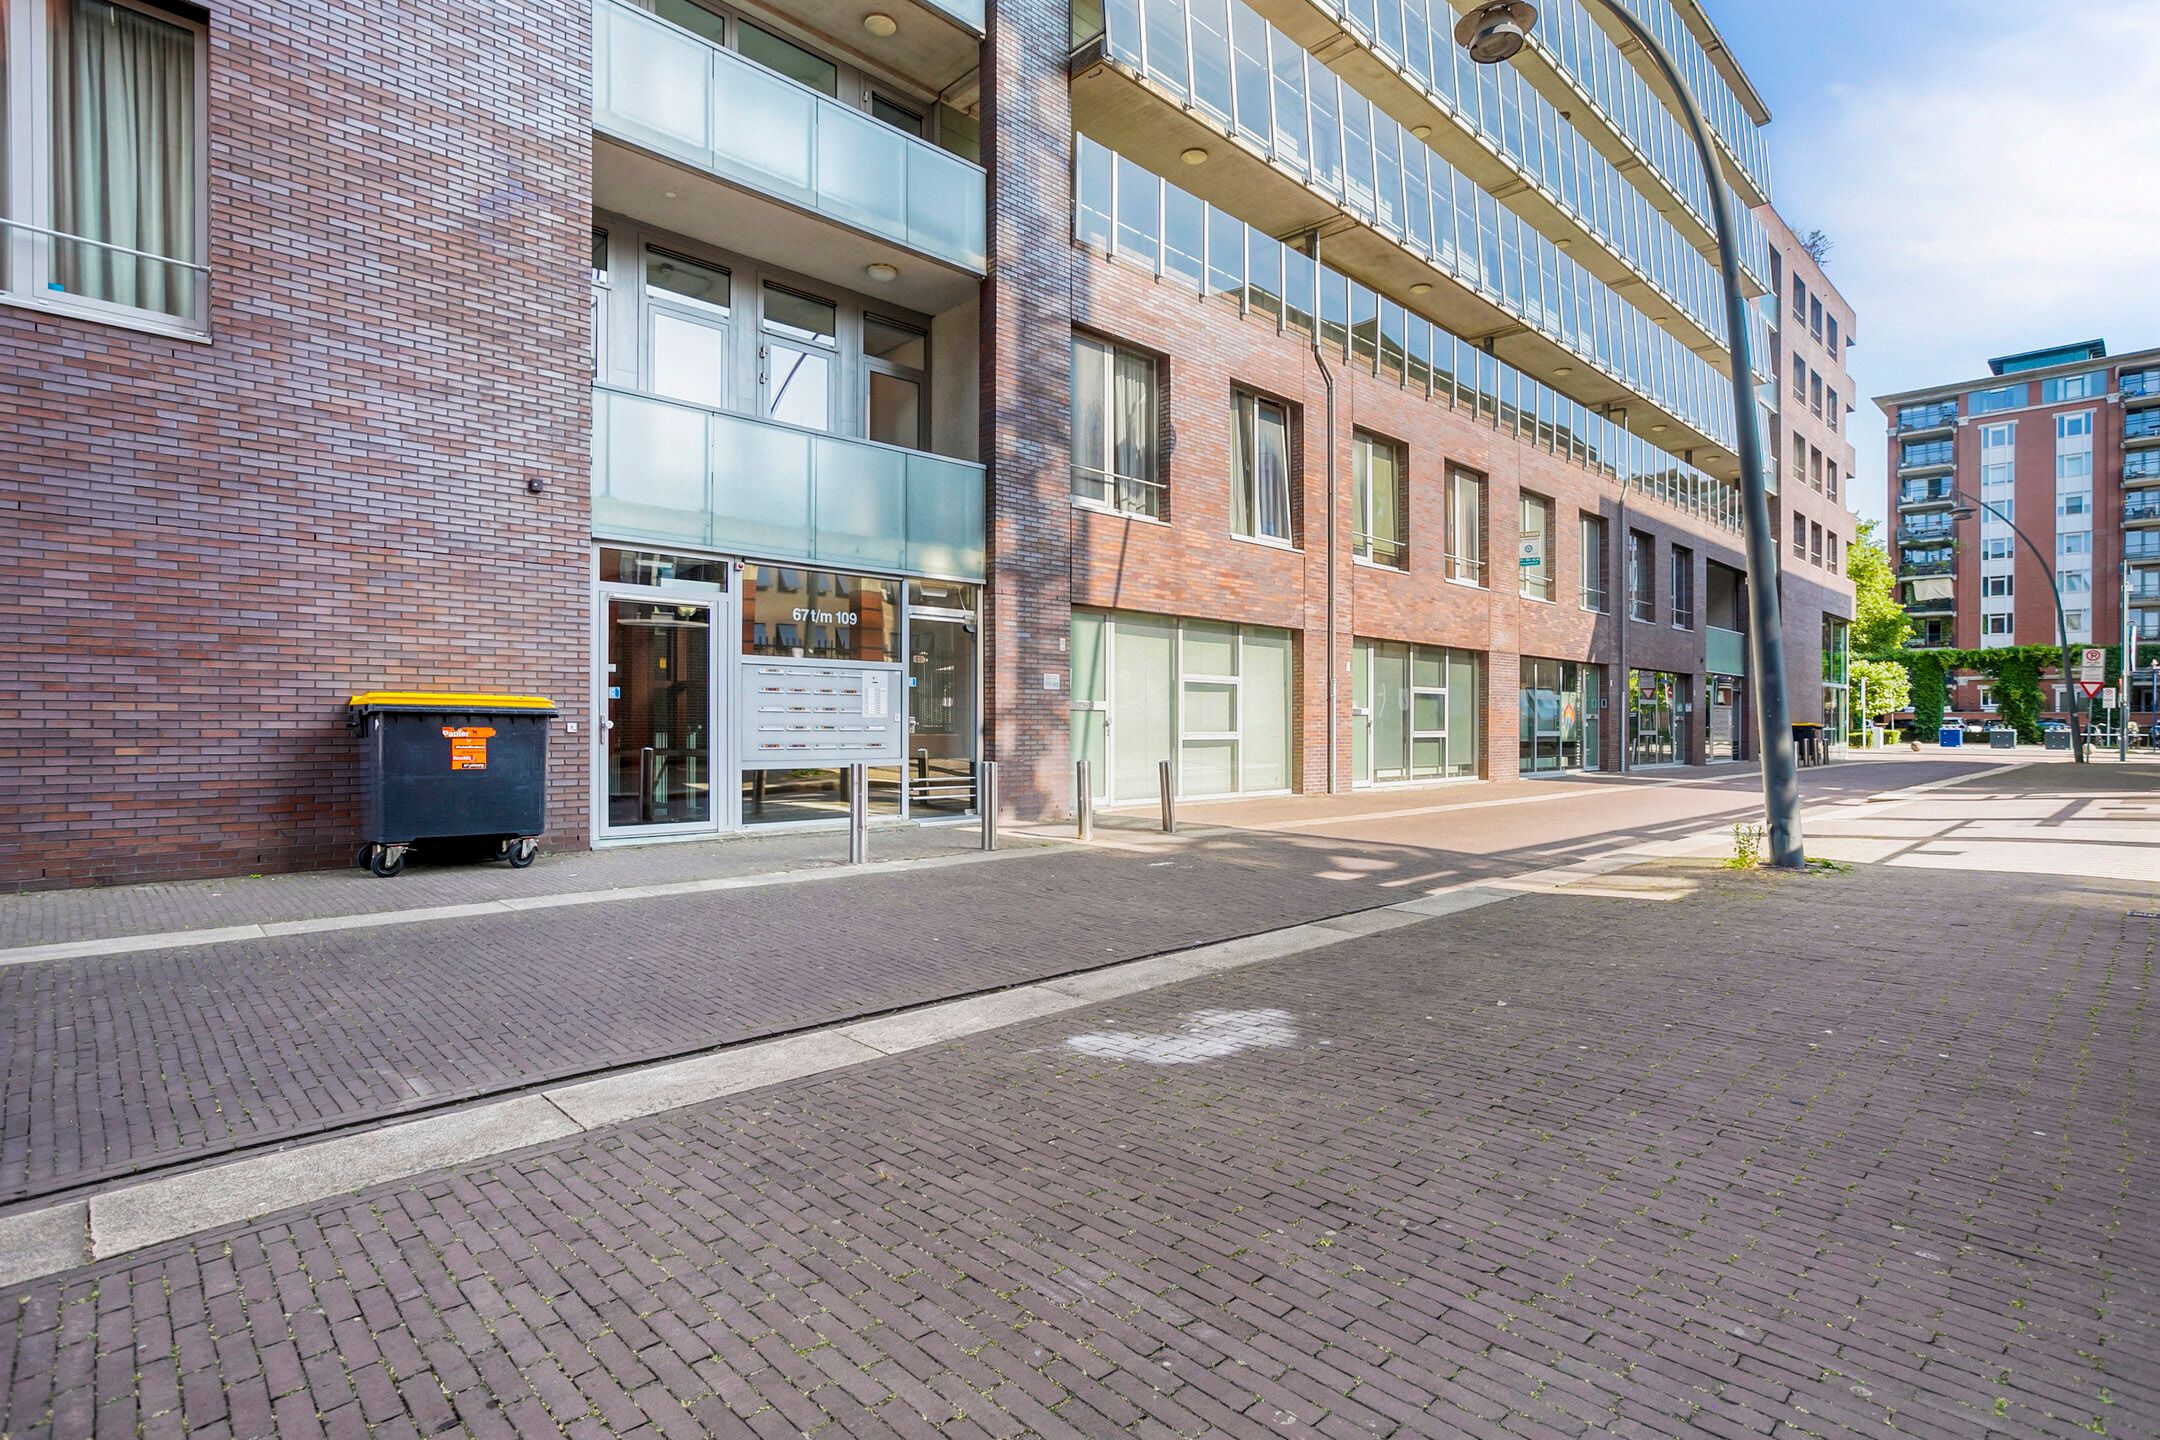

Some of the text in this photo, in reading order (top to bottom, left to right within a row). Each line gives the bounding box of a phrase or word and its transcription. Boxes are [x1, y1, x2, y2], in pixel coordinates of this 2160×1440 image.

[792, 608, 858, 625] 67 t/m 109
